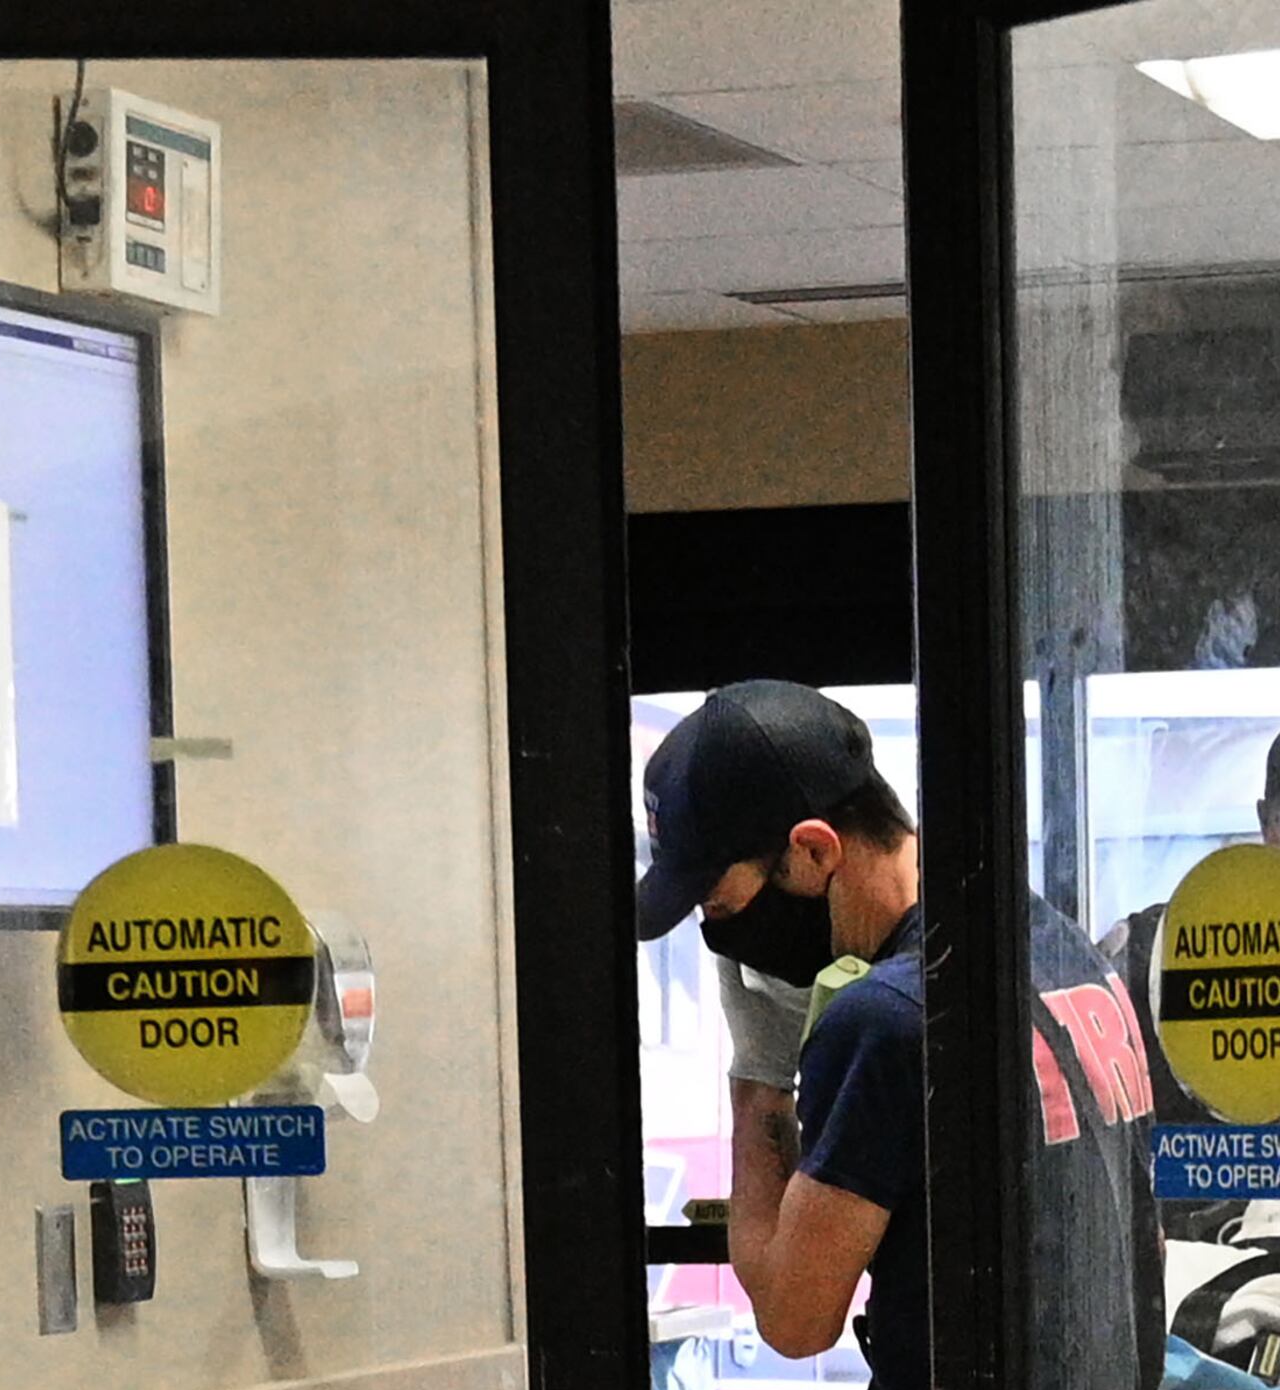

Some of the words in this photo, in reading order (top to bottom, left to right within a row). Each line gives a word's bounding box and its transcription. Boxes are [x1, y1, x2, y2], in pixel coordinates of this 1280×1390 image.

[87, 915, 282, 953] AUTOMATIC
[107, 968, 260, 1001] CAUTION
[140, 1017, 240, 1049] DOOR
[69, 1116, 201, 1142] ACTIVATE
[208, 1114, 316, 1139] SWITCH
[105, 1146, 143, 1170] TO
[150, 1143, 281, 1169] OPERATE
[1158, 1133, 1255, 1159] ACTIVATE
[1183, 1164, 1212, 1189] TO
